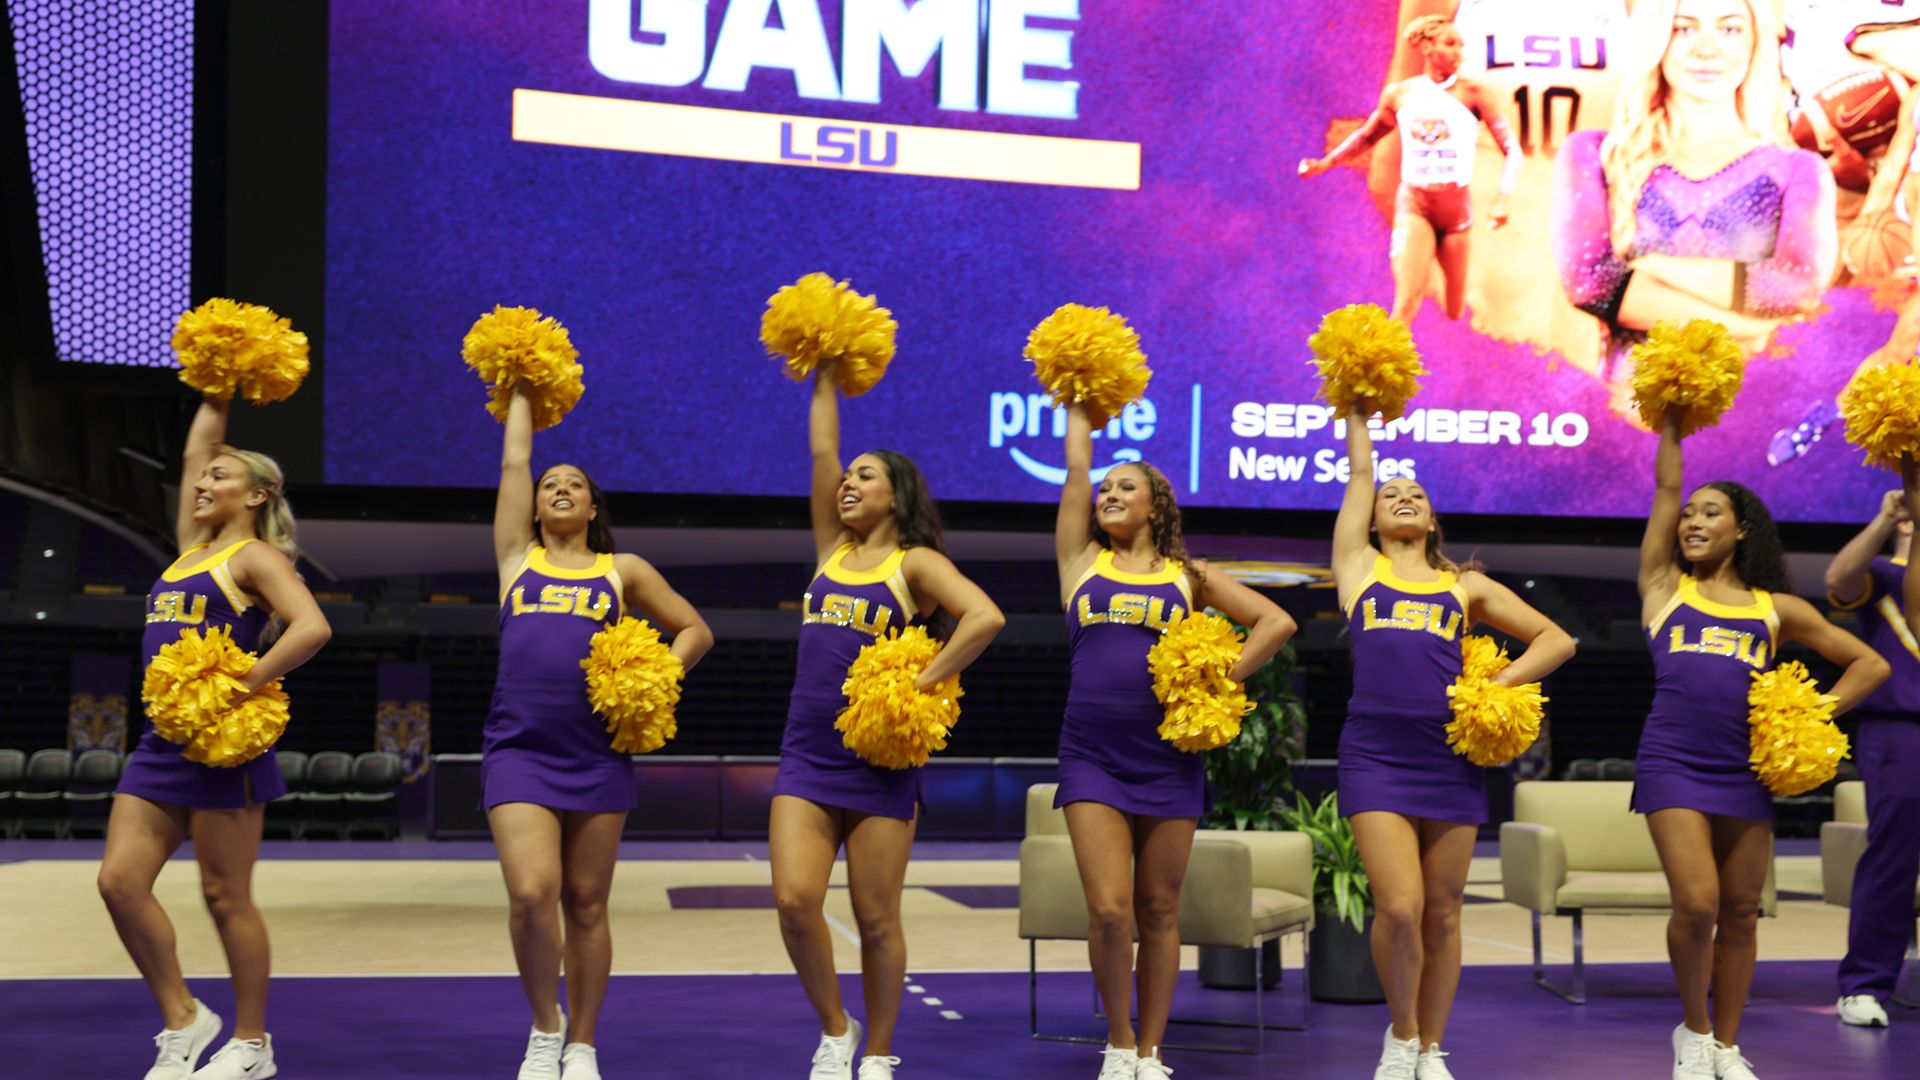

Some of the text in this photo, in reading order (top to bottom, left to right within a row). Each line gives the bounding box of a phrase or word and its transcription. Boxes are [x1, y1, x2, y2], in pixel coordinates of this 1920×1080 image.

[588, 0, 1080, 119] GAME
[1486, 34, 1606, 70] LSU
[780, 121, 897, 167] LSU
[1514, 84, 1581, 159] 10
[989, 391, 1157, 448] prie
[1527, 412, 1589, 447] 10
[1229, 446, 1417, 484] New Seies
[511, 584, 612, 621] LSU
[802, 592, 892, 637] LSU
[1077, 592, 1185, 634] LSU
[1362, 597, 1462, 642] LSU
[1668, 624, 1768, 669] LSU
